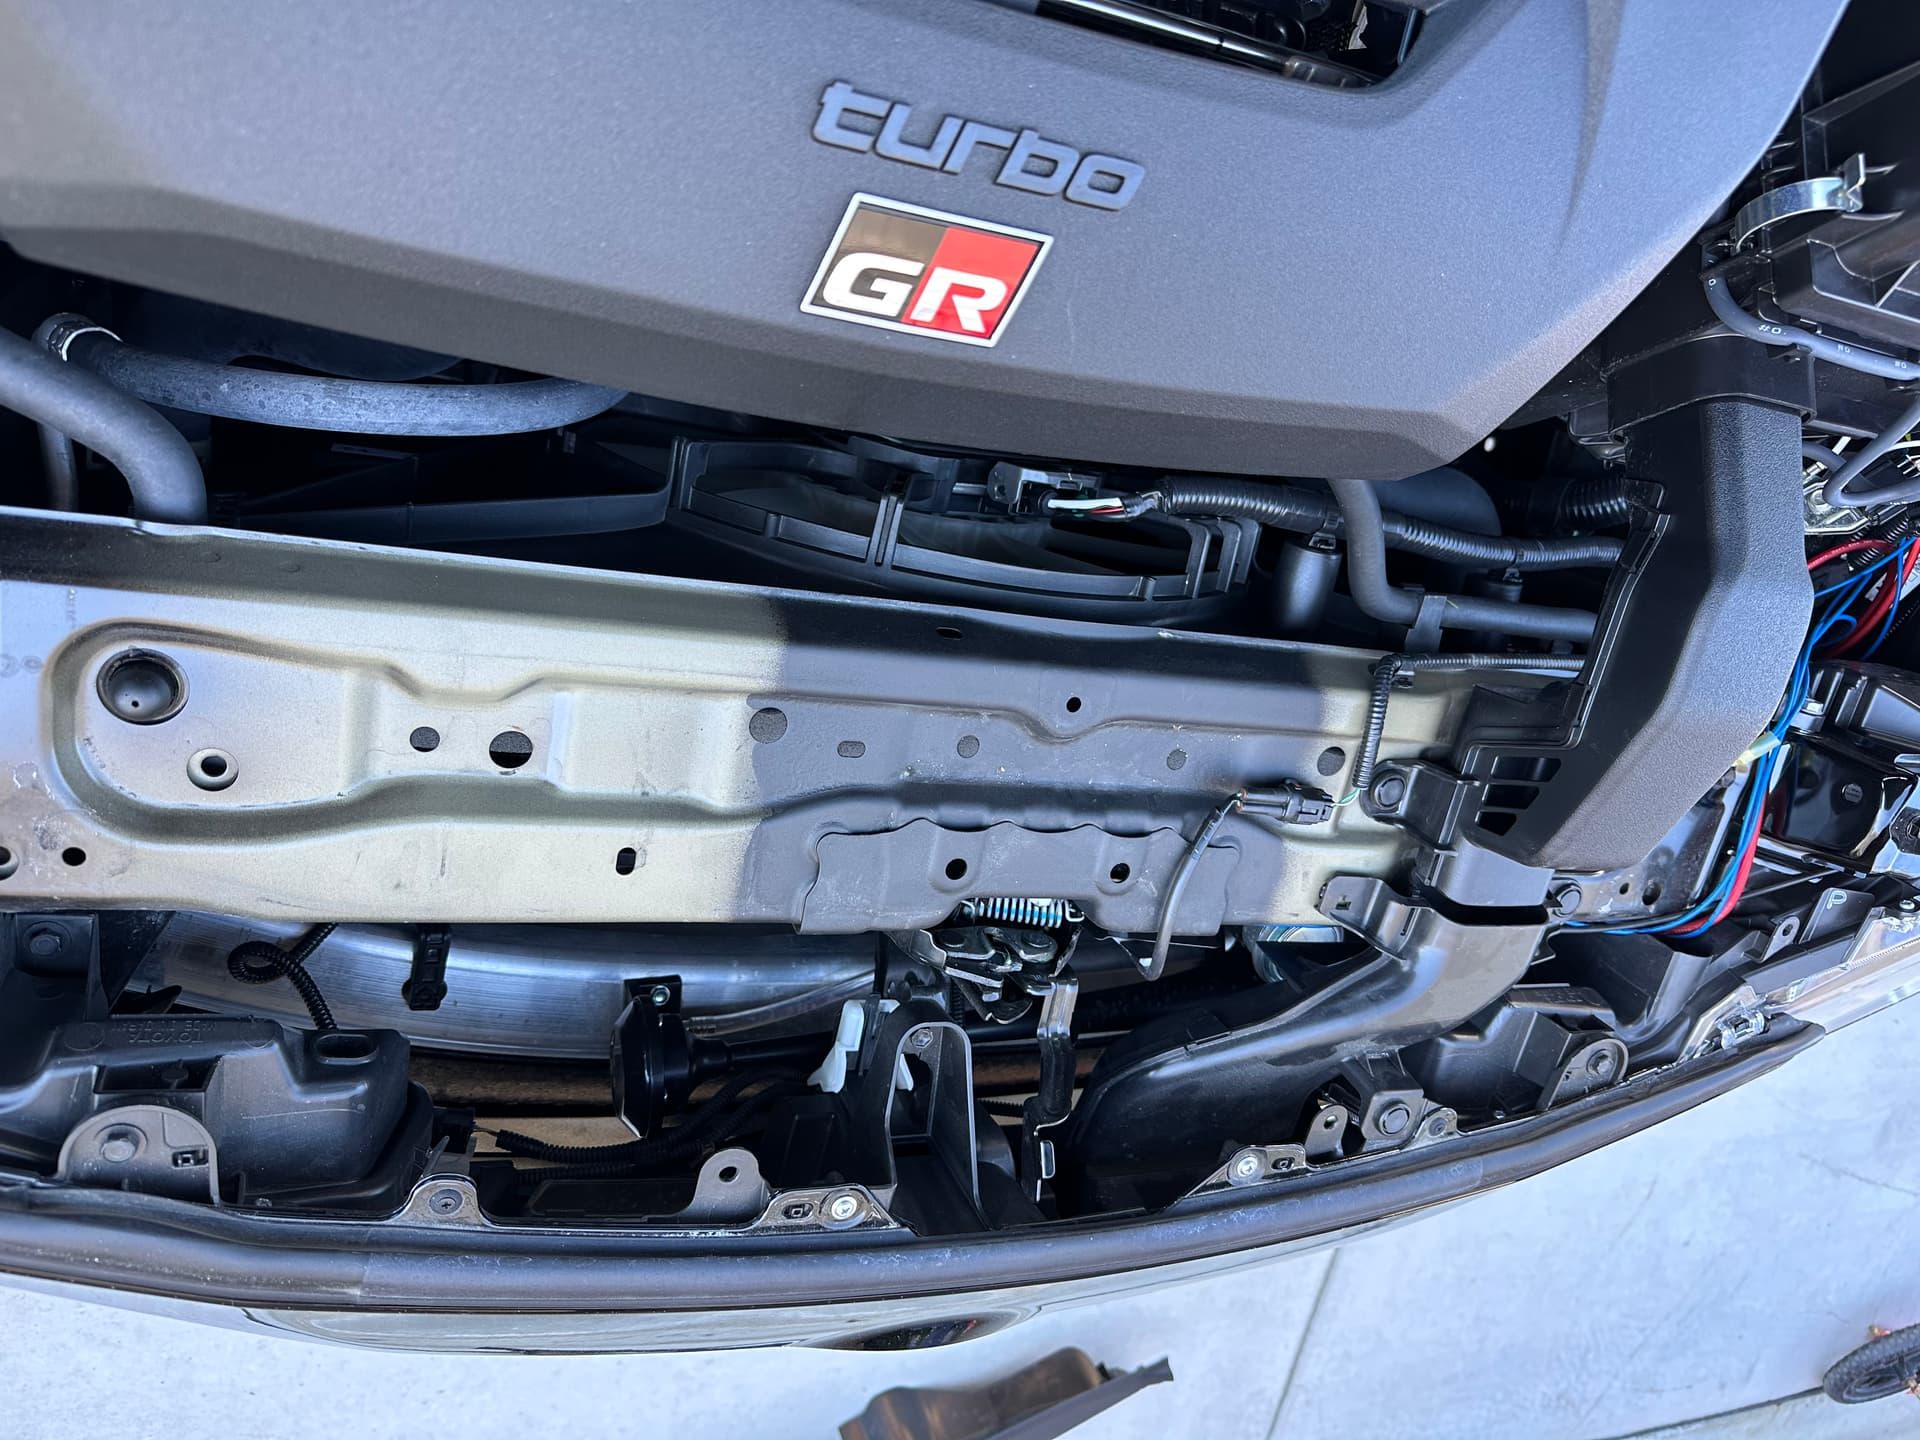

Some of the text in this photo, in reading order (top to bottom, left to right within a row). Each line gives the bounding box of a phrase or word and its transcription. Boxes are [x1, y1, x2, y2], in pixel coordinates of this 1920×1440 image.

[812, 80, 1146, 211] turbo
[822, 252, 1008, 334] GR
[128, 1032, 205, 1043] TOYOTA
